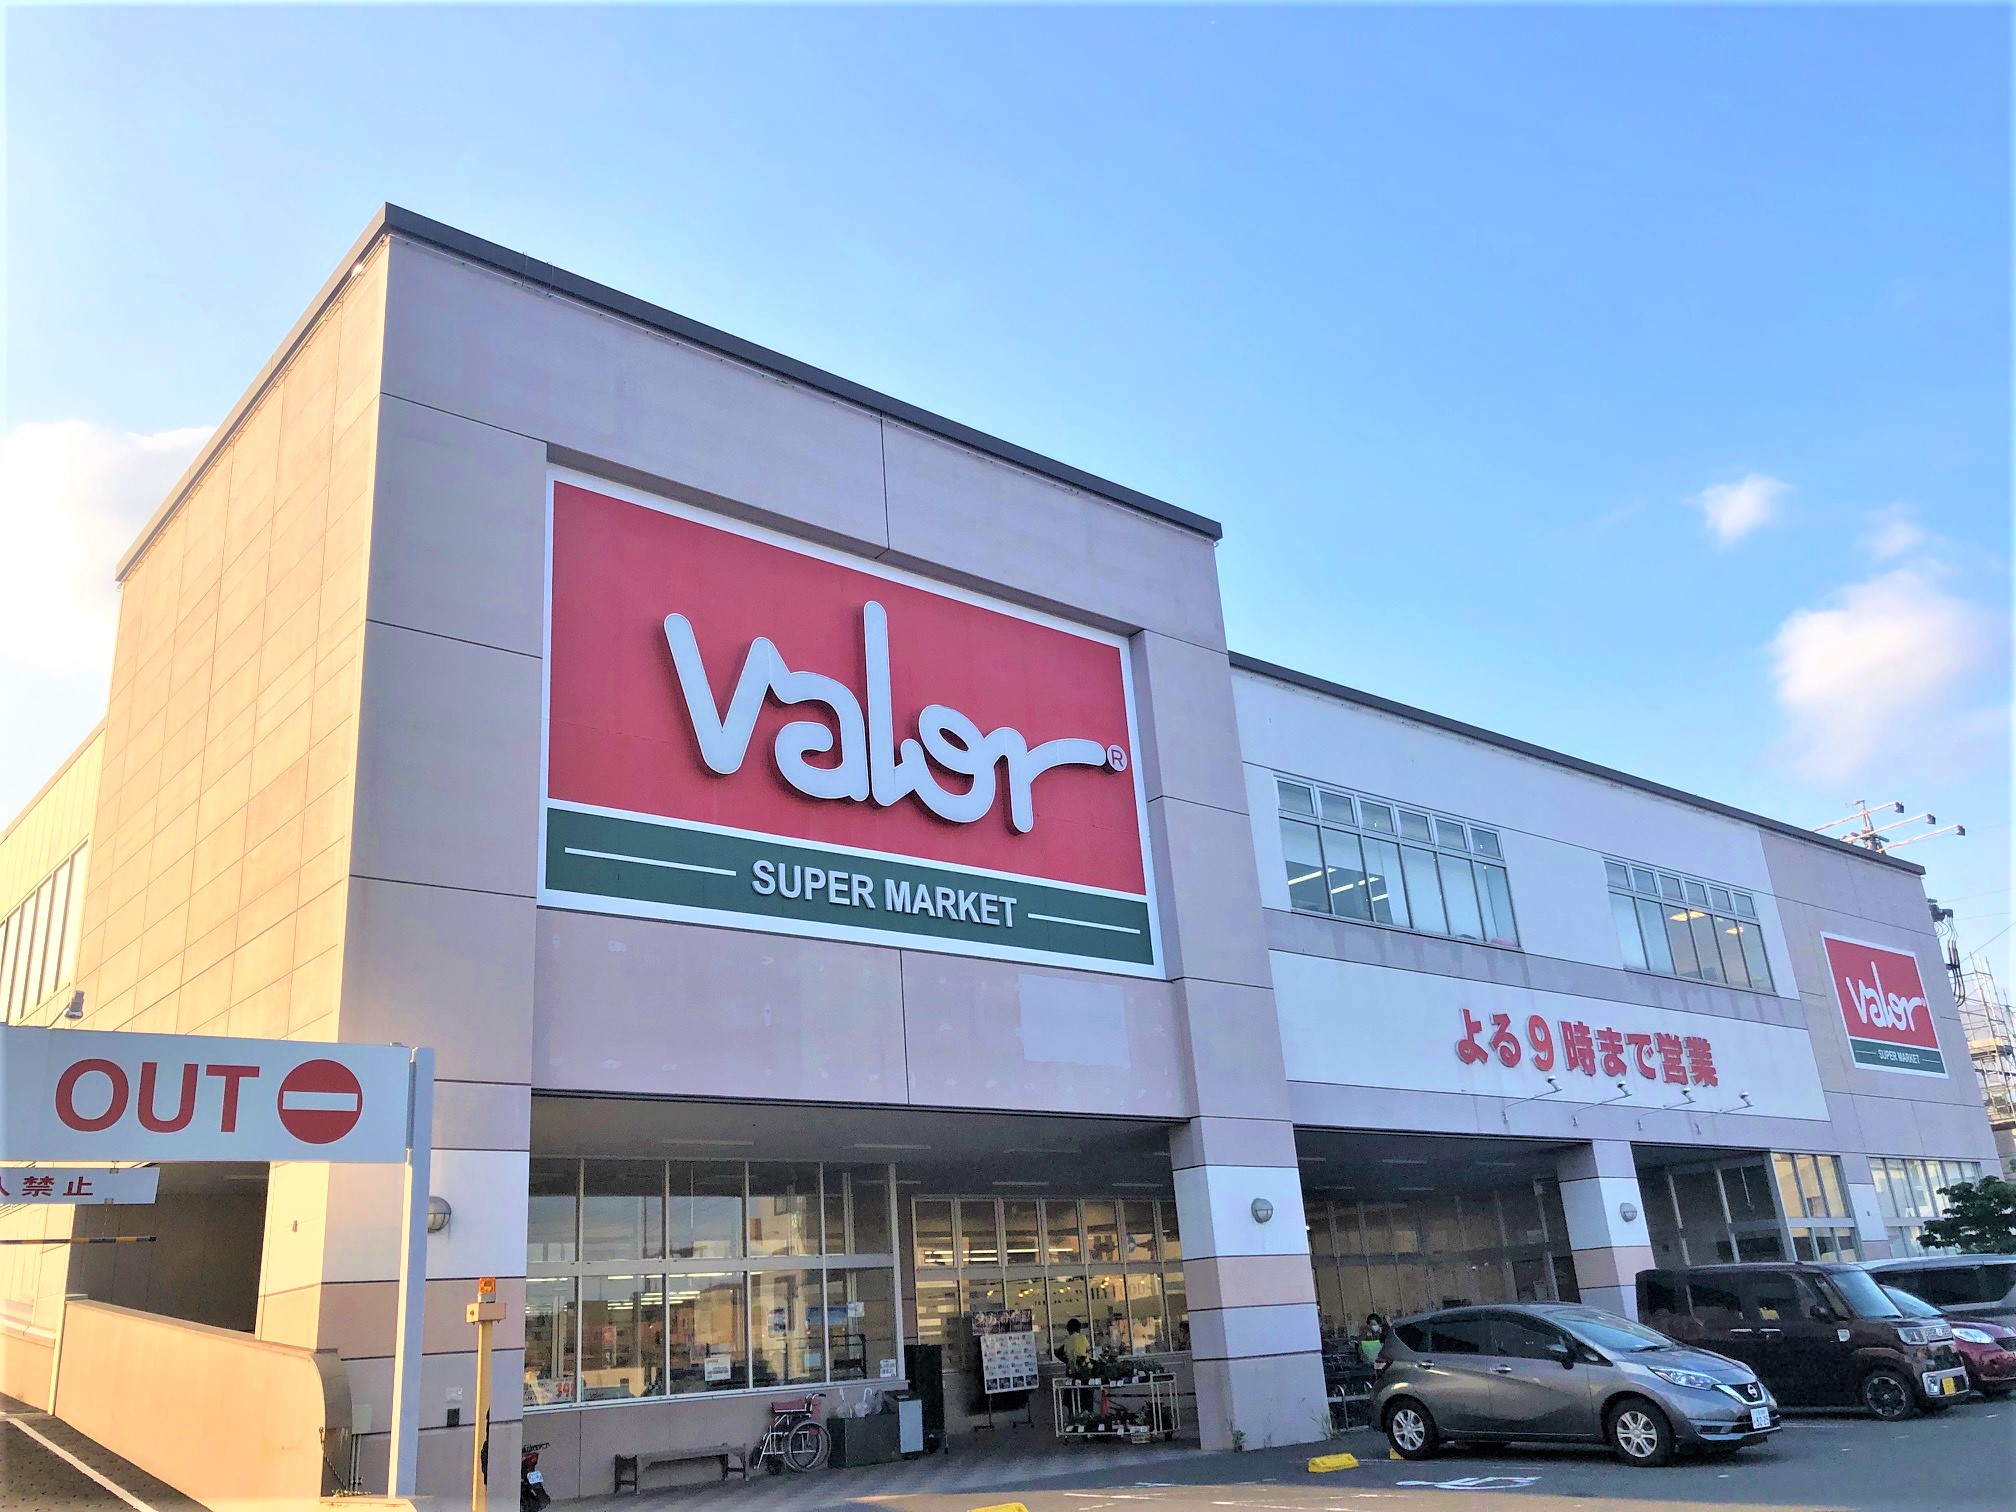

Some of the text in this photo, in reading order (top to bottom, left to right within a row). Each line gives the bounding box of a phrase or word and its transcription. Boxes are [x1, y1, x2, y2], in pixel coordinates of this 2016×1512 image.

[751, 859, 1018, 928] SUPER MARKET
[1455, 1008, 1719, 1088] よる9時まで営業
[1877, 1049, 1920, 1064] SUPER MARKET
[55, 1058, 260, 1133] OUT
